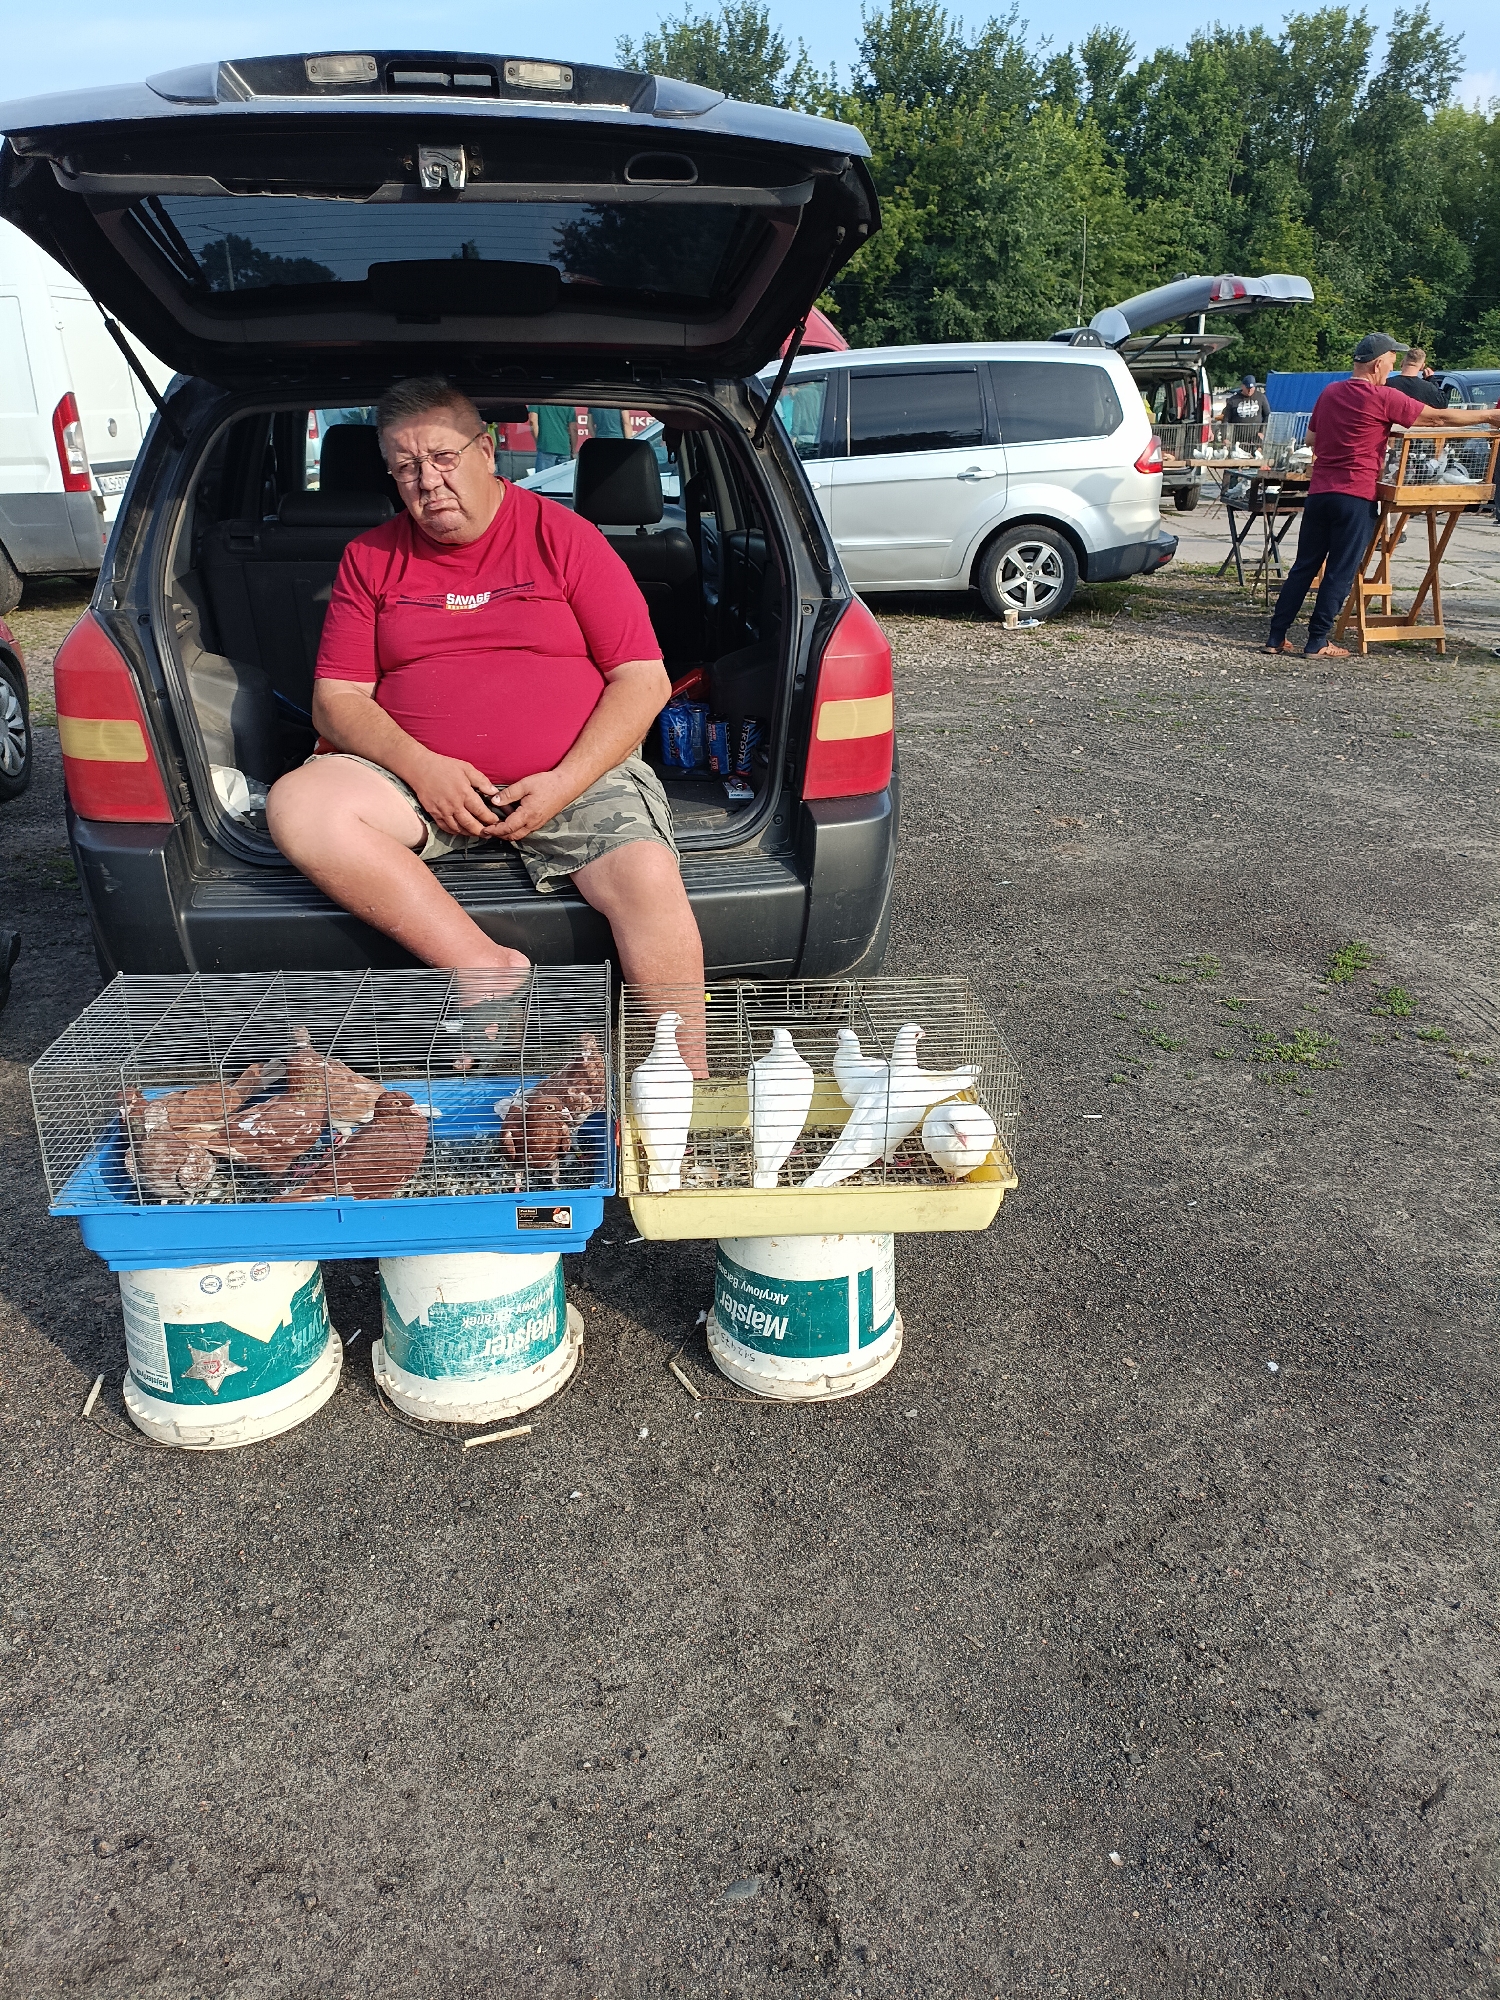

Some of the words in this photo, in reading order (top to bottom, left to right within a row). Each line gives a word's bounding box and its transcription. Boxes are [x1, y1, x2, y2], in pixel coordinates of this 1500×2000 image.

[446, 591, 491, 605] SAVAGE
[667, 725, 677, 758] TIGER
[738, 725, 750, 764] TIGER
[740, 1280, 790, 1306] Akrylowy
[462, 1307, 511, 1329] ranek
[720, 1290, 789, 1340] Majster
[484, 1308, 557, 1356] Majster
